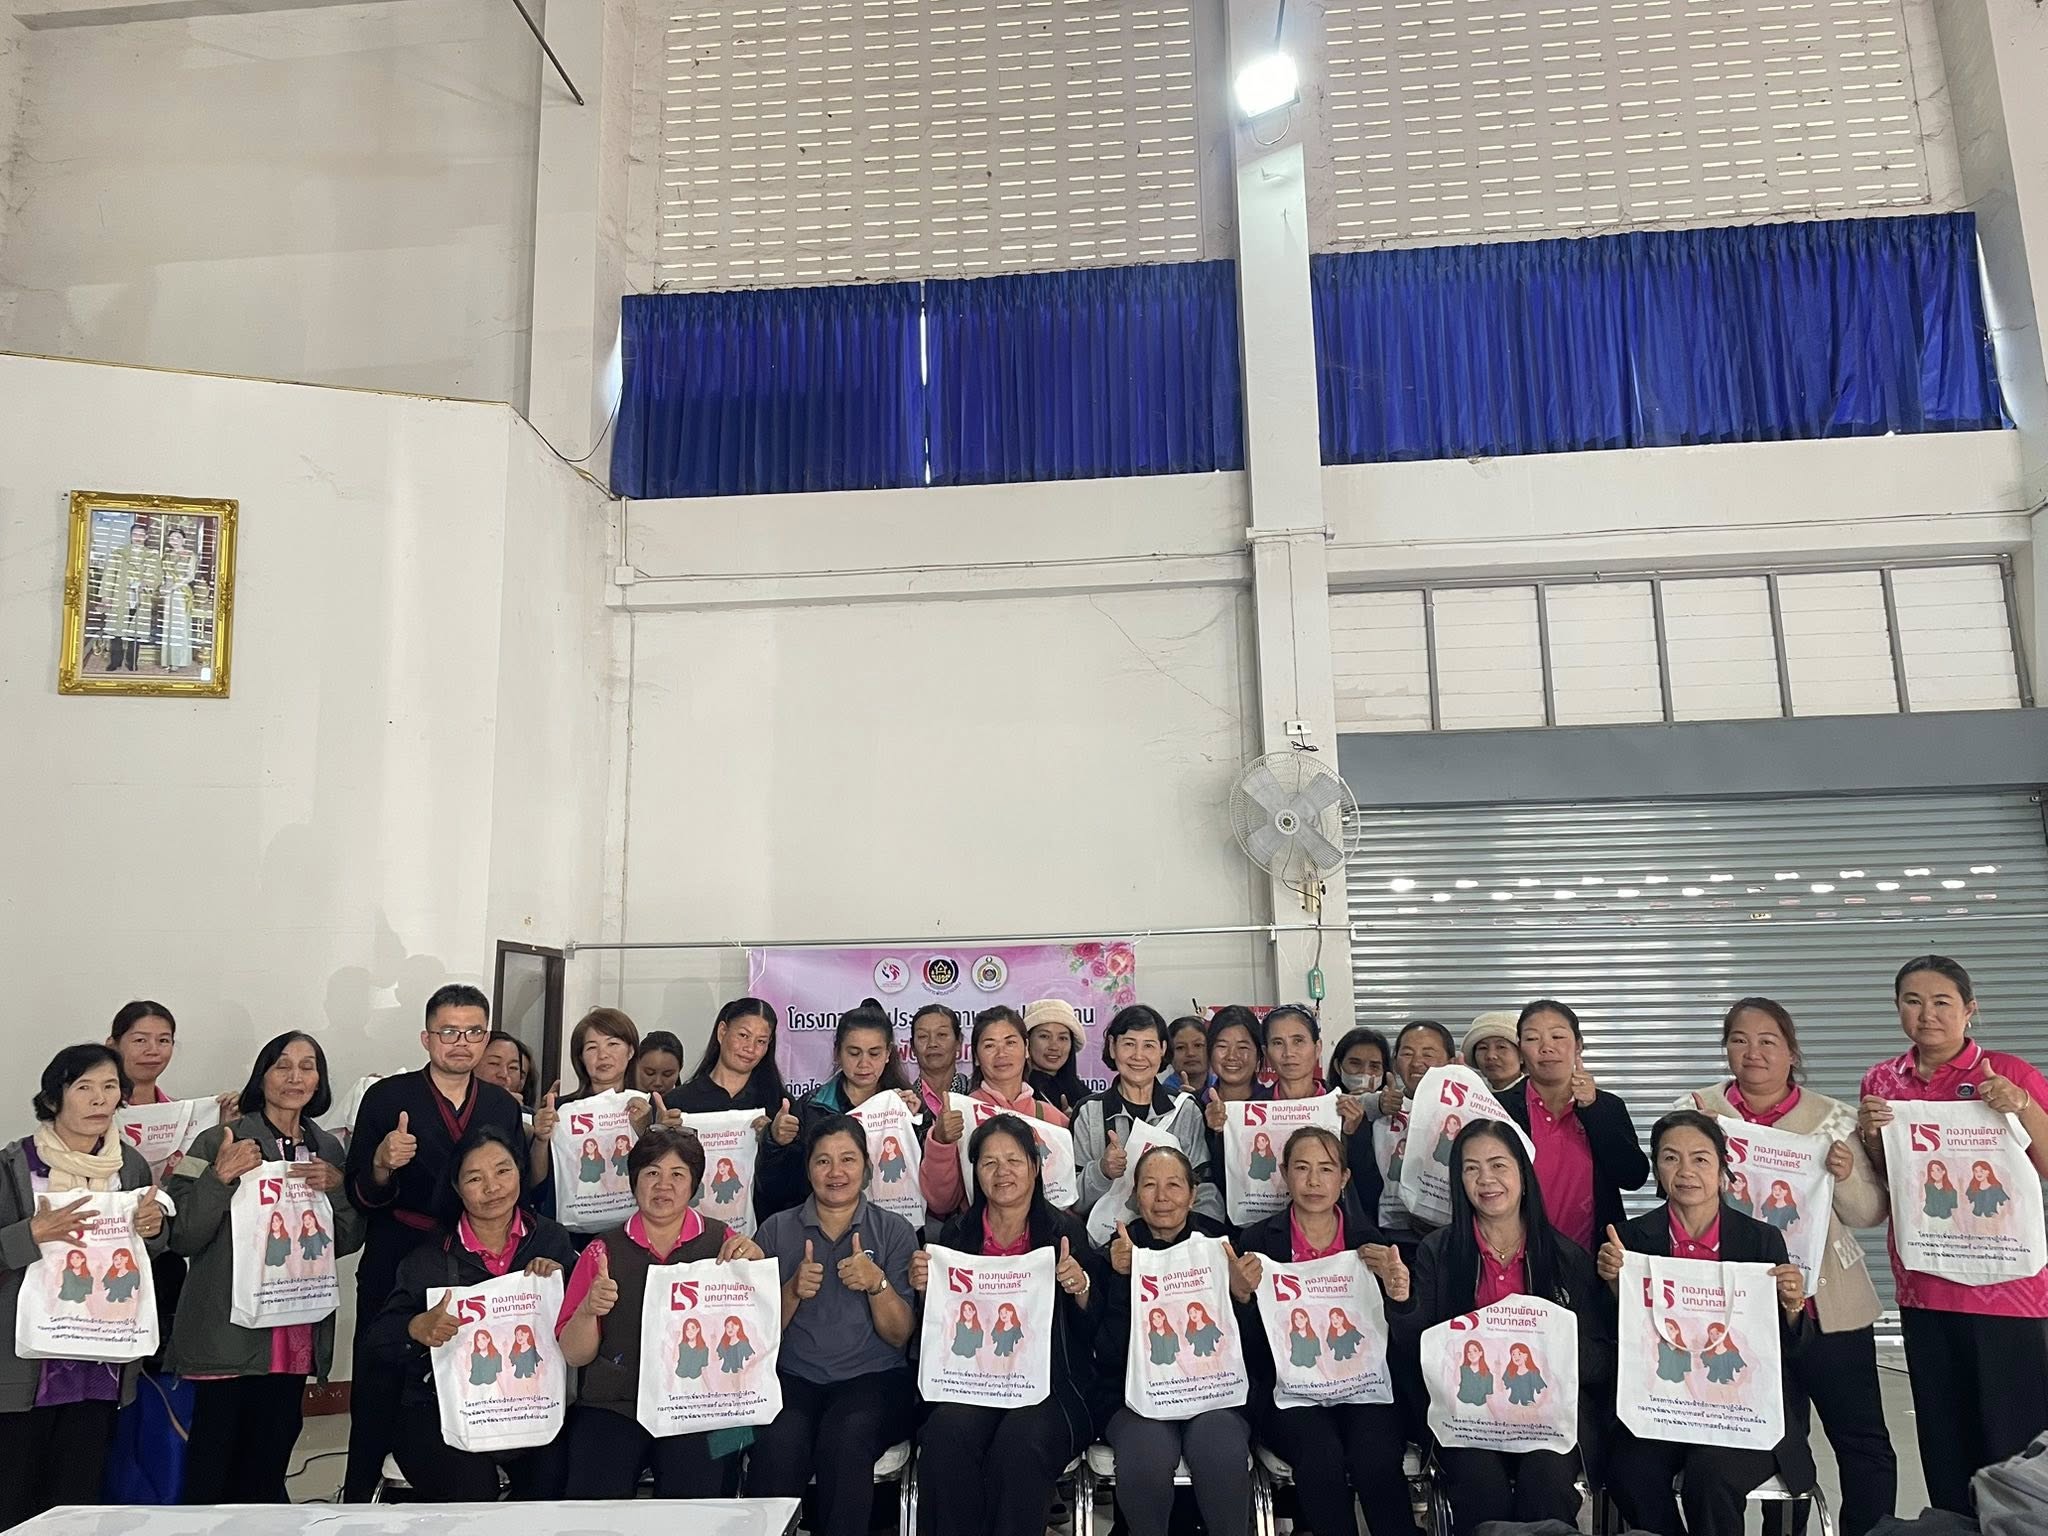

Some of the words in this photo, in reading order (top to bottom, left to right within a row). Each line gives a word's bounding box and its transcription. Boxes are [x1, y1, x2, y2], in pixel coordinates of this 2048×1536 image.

[1271, 1104, 1320, 1114] กองทุนพัฒนา
[1271, 1113, 1311, 1121] บทบาทสตรี
[1946, 1126, 2007, 1138] กองทุนพัฒนา
[1947, 1136, 1998, 1146] บทบาทสตรี
[1754, 1145, 1812, 1161] กองทุนพัฒนา
[1753, 1155, 1801, 1169] บทบาทสตรี
[978, 1271, 1031, 1282] กองทุนพัฒนา
[1162, 1266, 1212, 1283] กองทุนพัฒนา
[704, 1282, 756, 1294] กองทุนพัฒนา
[978, 1280, 1022, 1290] บทบาทสตรี
[1163, 1277, 1205, 1291] บทบาทสตรี
[1307, 1284, 1348, 1293] บทบาทสตรี
[704, 1292, 749, 1302] บทบาทสตรี
[492, 1303, 536, 1314] บทบาทสตรี
[1486, 1306, 1548, 1317] กองทุนพัฒนา
[1486, 1316, 1537, 1327] บทบาทสตรี
